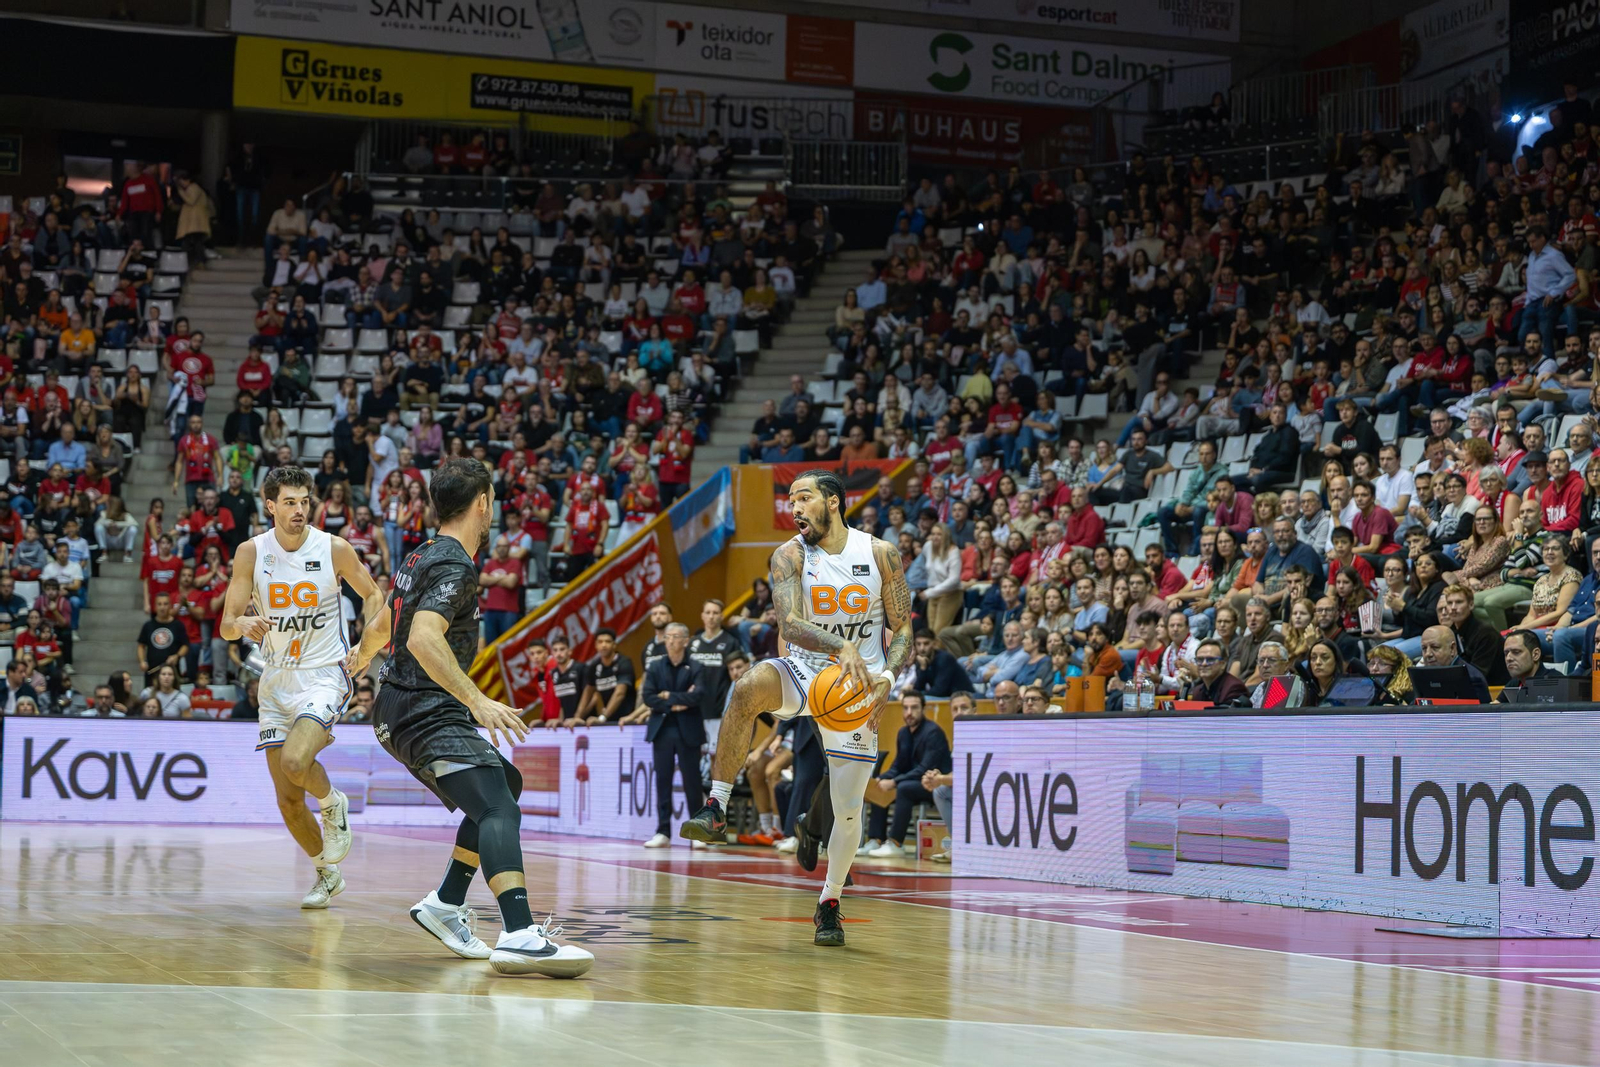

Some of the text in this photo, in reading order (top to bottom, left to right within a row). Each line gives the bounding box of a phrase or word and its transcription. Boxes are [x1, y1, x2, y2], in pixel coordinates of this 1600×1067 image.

[369, 0, 443, 22] SANT
[447, 3, 535, 30] ANIOL
[1037, 5, 1117, 25] esportcat
[1552, 0, 1600, 41] PAC
[702, 23, 775, 46] teixidor
[701, 44, 732, 61] ota
[992, 43, 1174, 83] Sant Dalmai
[311, 59, 383, 83] Grues
[311, 81, 404, 107] Viñolas
[992, 75, 1132, 106] Food Compay
[712, 94, 847, 137] fustech
[869, 110, 1022, 144] BAUHAUS
[268, 581, 319, 609] BG
[810, 583, 871, 616] BG
[289, 638, 301, 660] 4
[22, 737, 208, 802] Kave
[965, 751, 1079, 852] Kave
[1355, 755, 1596, 890] Home
